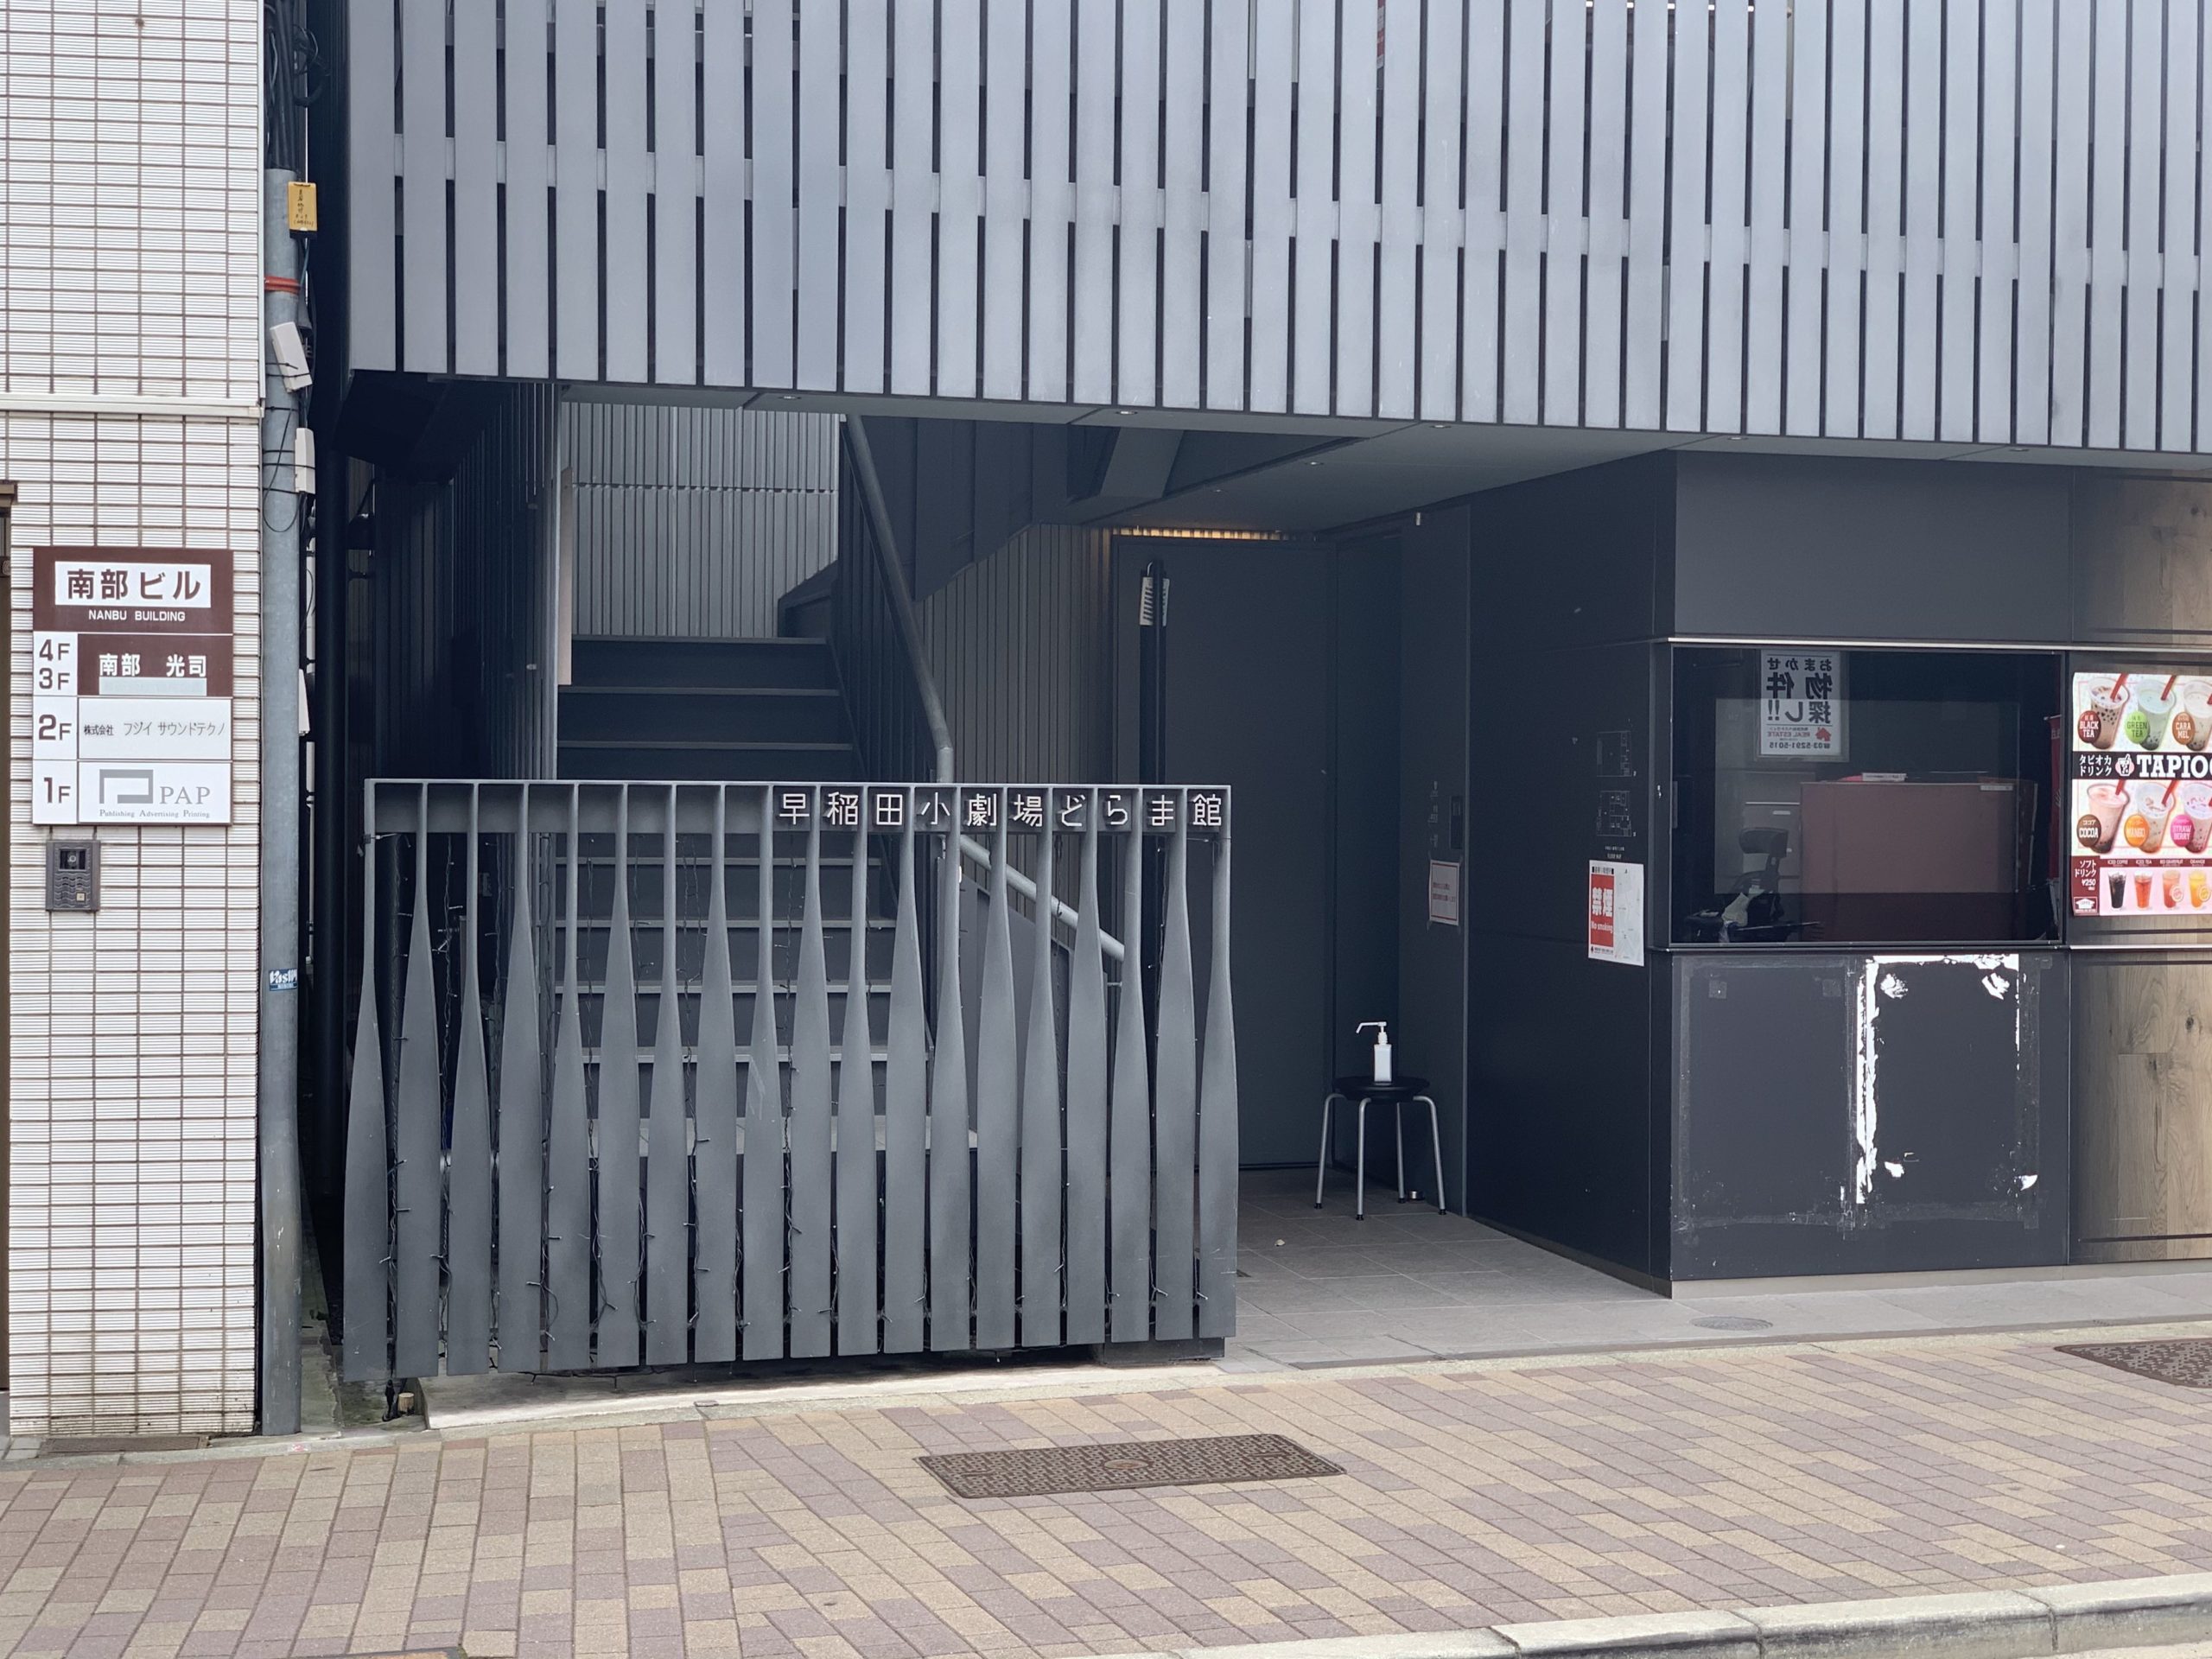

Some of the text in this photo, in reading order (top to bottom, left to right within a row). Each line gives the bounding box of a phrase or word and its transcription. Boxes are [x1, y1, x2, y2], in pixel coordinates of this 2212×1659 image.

[67, 569, 200, 600] 南部ビル
[88, 609, 186, 621] NANBU BUILDING
[39, 639, 71, 661] 4F
[99, 653, 207, 677] 南部 光司
[39, 668, 71, 690] 3F
[39, 714, 72, 741] 2F
[84, 721, 226, 735] 株式会社 フジイ サウンドテクノ
[2079, 721, 2099, 729] BLACK
[2126, 721, 2147, 730] GREEN
[2083, 729, 2095, 738] TEA
[2079, 754, 2112, 766] タピオカ
[2137, 754, 2212, 779] TAPIO
[2080, 766, 2112, 777] ドリンク
[44, 777, 71, 804] 1F
[160, 786, 211, 804] PAP
[99, 809, 210, 818] Publishing Advertising Printing
[779, 792, 1223, 827] 早稲田小劇場どらま館
[2079, 829, 2099, 838] COCOA
[2075, 868, 2097, 878] ドリンク
